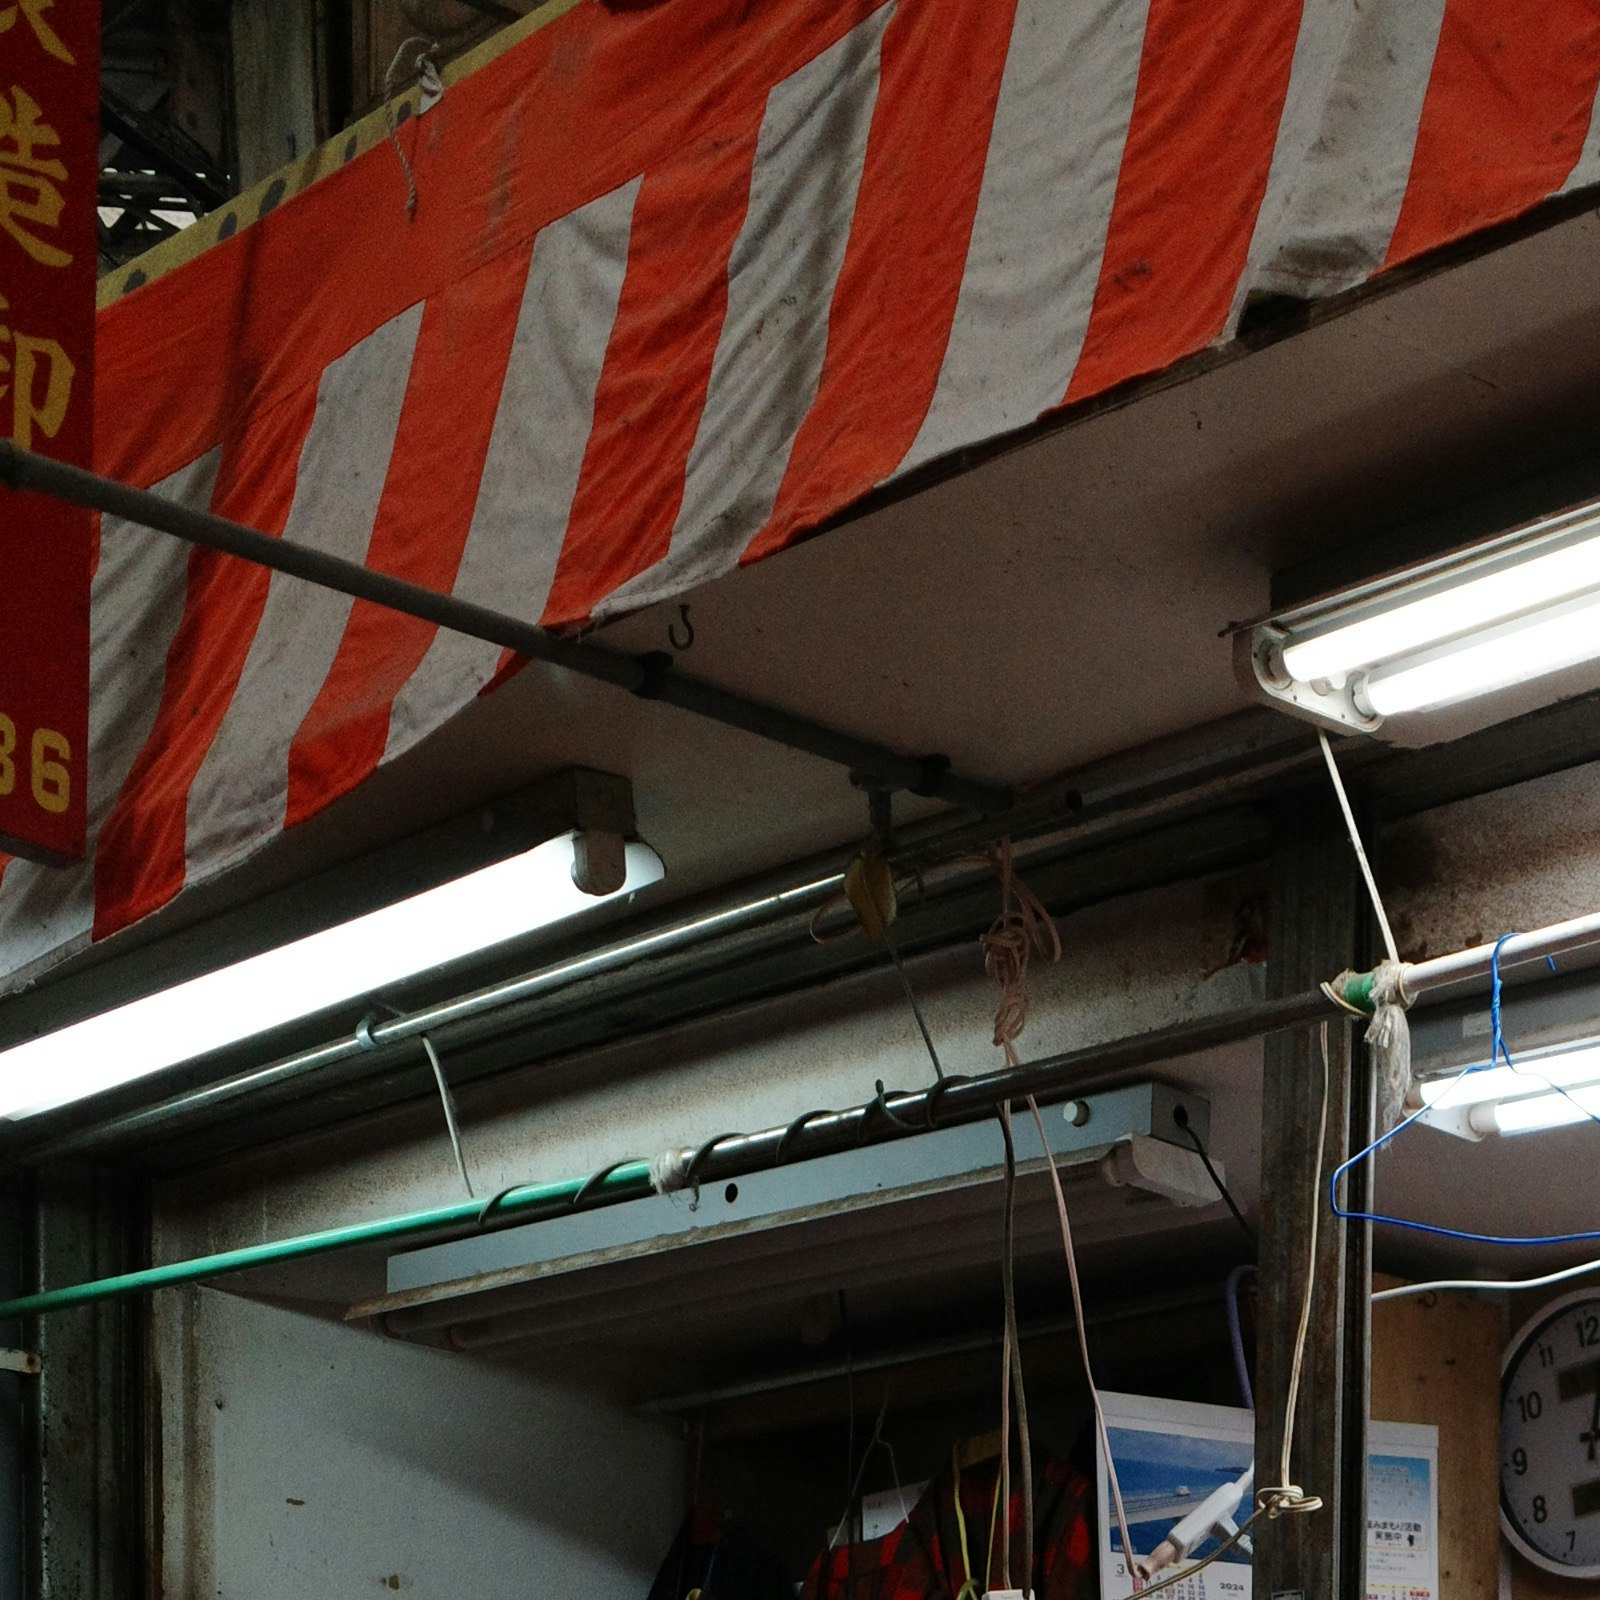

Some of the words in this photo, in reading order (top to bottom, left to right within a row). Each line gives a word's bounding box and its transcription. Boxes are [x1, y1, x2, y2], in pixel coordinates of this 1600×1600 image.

[0, 0, 77, 455] 造卸
[1576, 1316, 1600, 1347] 12
[1539, 1346, 1555, 1368] 11
[1518, 1391, 1542, 1422] 10
[1512, 1447, 1528, 1475] 9
[1532, 1495, 1547, 1523] 8
[1566, 1530, 1576, 1550] 7
[1117, 1564, 1125, 1574] 3
[1219, 1582, 1245, 1591] 2024
